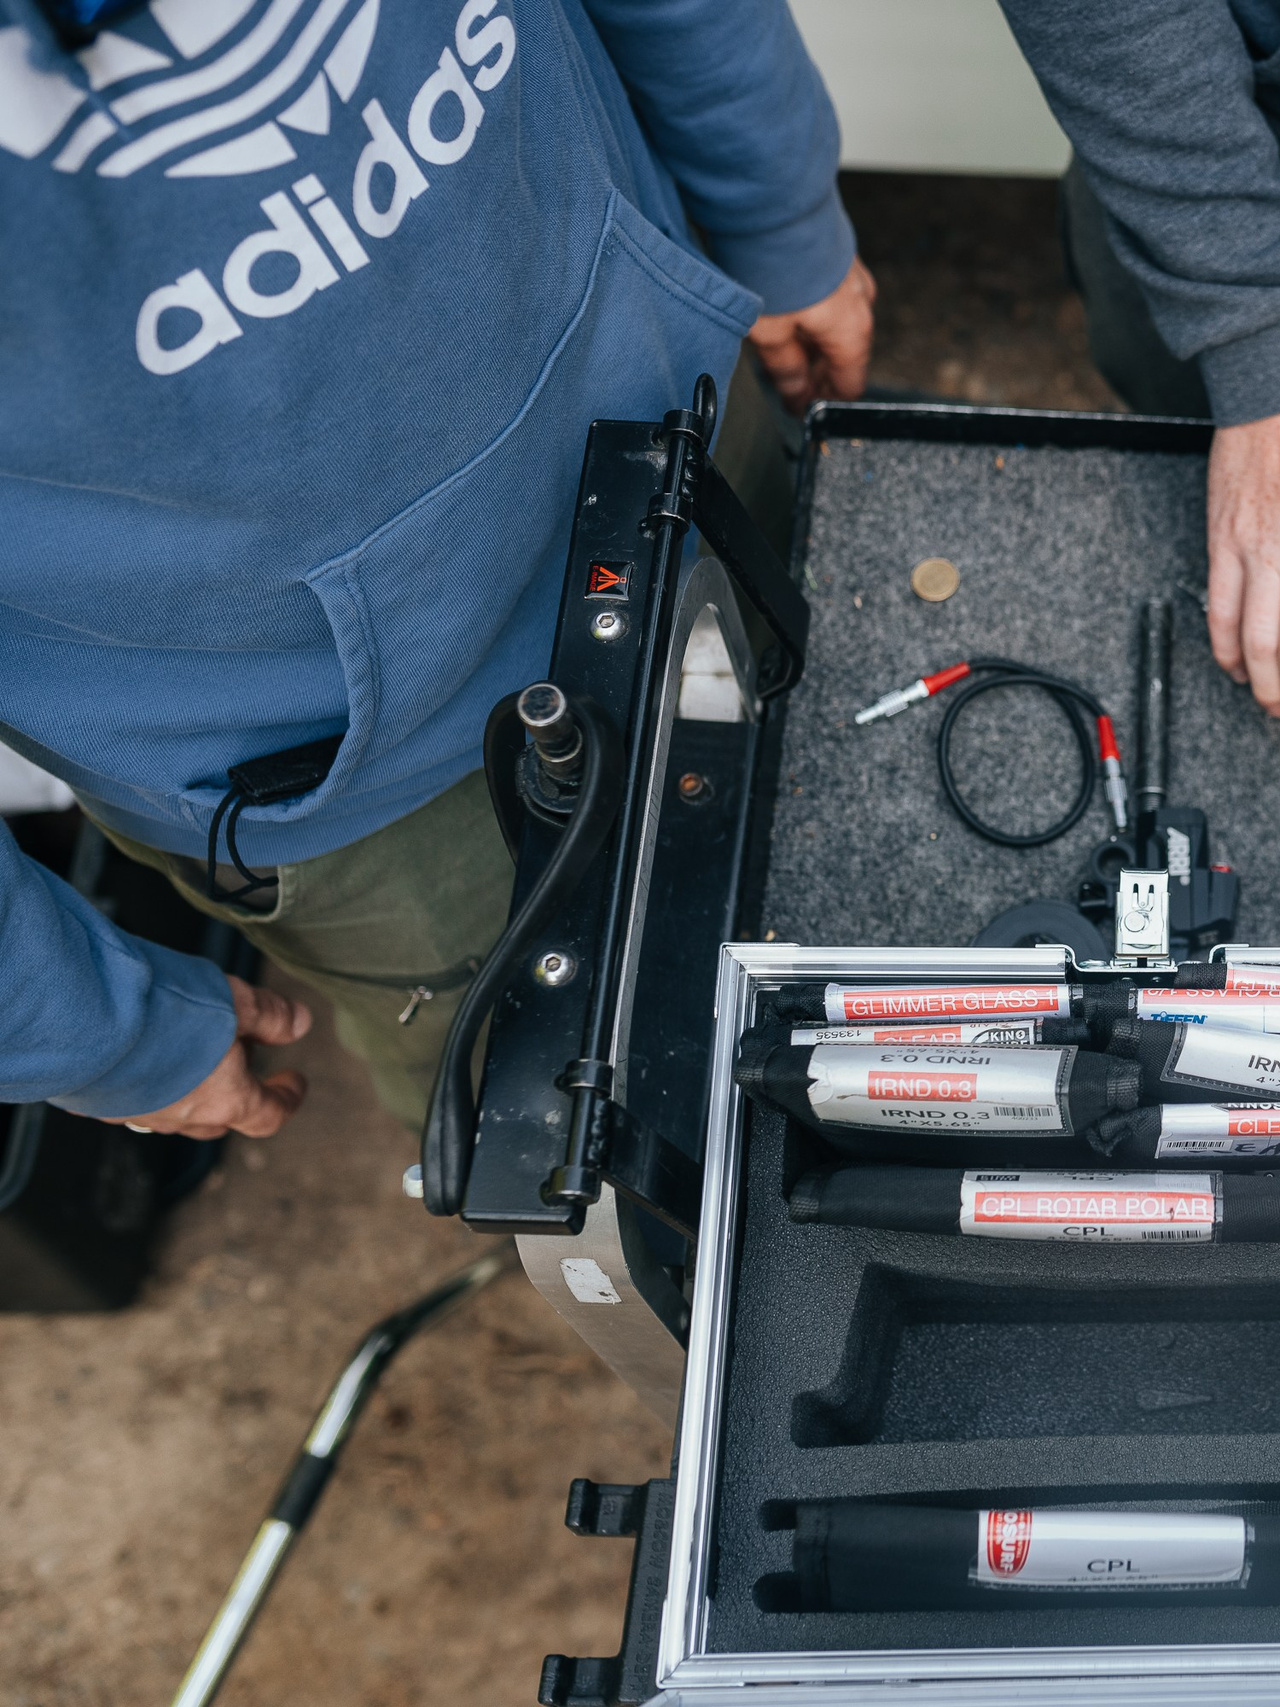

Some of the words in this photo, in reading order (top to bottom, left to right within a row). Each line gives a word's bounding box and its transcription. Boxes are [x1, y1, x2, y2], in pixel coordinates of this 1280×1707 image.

[135, 0, 517, 375] adidas
[1167, 826, 1190, 876] ARRI
[852, 995, 956, 1016] GLIMMER
[963, 989, 1039, 1010] GLASS
[816, 1029, 862, 1041] 133535
[880, 1054, 919, 1063] 0.3
[926, 1055, 991, 1065] IRND
[874, 1078, 932, 1097] IRND
[938, 1080, 972, 1098] 0.3
[881, 1109, 946, 1119] IRND
[953, 1111, 990, 1120] 0.3
[982, 1197, 1029, 1218] CPL
[1036, 1197, 1117, 1217] ROTAR
[1125, 1197, 1208, 1218] POLAR
[1063, 1226, 1114, 1237] CPL
[1087, 1559, 1140, 1574] CPL
